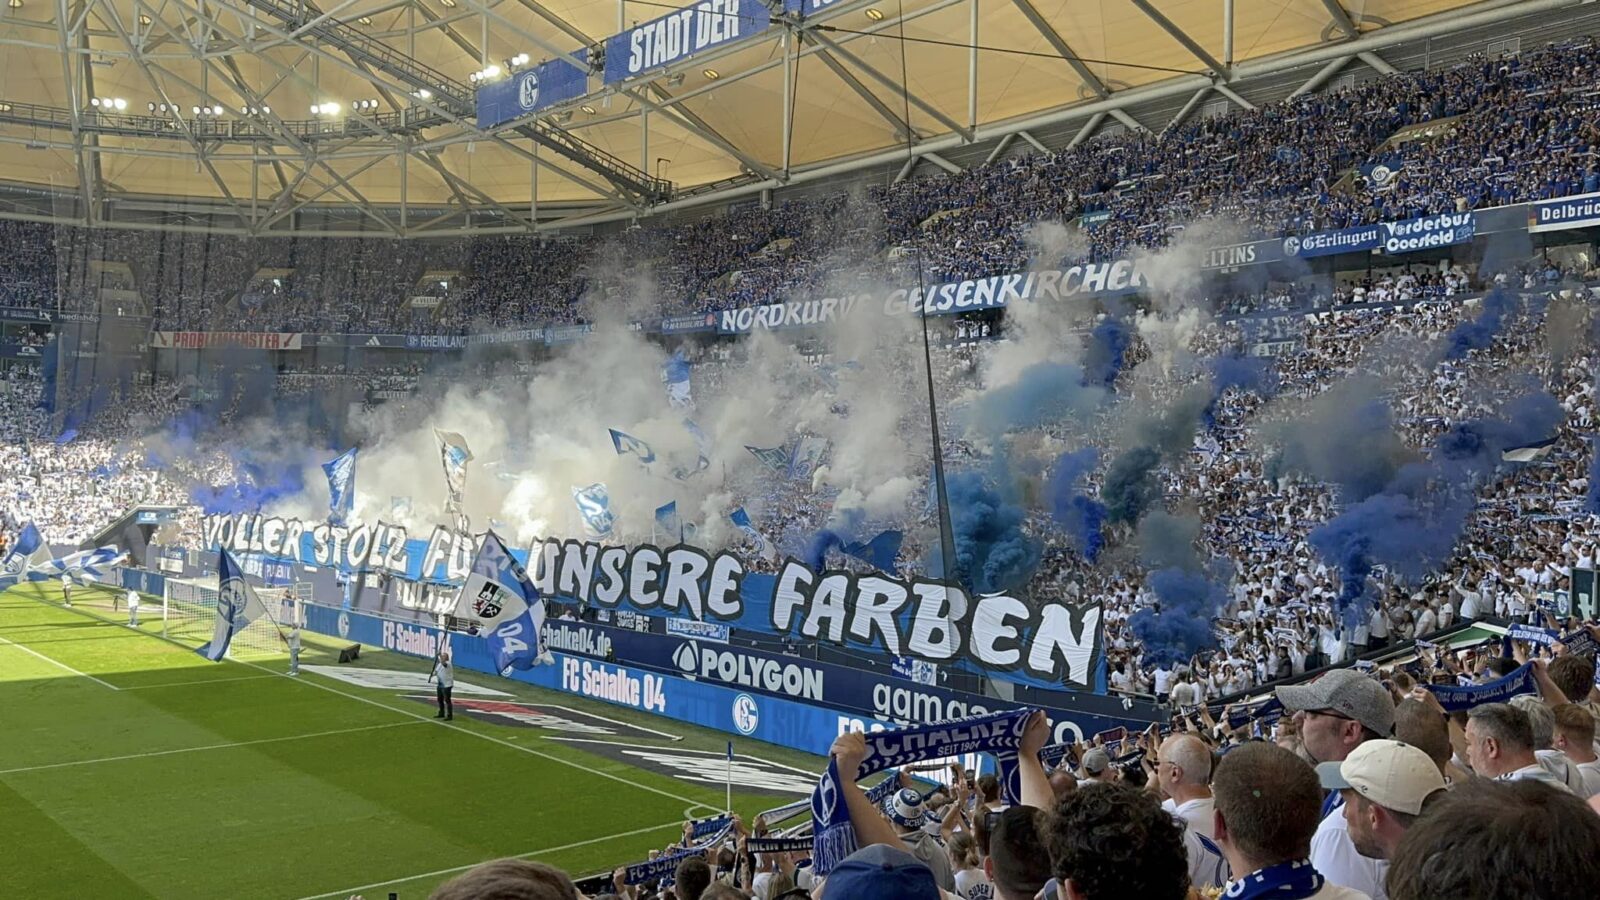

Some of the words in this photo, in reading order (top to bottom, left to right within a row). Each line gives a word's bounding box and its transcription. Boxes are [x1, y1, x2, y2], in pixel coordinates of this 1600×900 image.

[628, 9, 693, 73] STADT
[695, 0, 740, 49] DER
[1202, 245, 1256, 268] ELTINS
[1386, 229, 1454, 252] Coesfeld
[721, 293, 870, 333] NORDKURV
[420, 334, 466, 349] RHEINLAND
[203, 513, 300, 561] VOLLER
[313, 522, 407, 572] STOLZ
[526, 537, 743, 620] UNSERE
[773, 560, 1099, 686] FARBEN
[382, 619, 395, 650] FC
[396, 622, 436, 659] Schalke
[541, 623, 612, 658] chalke04.de
[562, 656, 580, 692] FC
[582, 660, 640, 707] Schalke
[643, 673, 666, 713] 04
[701, 647, 824, 701] POLYGON
[937, 743, 959, 756] SEIT
[629, 866, 645, 881] FC
[649, 857, 681, 875] SCHA
